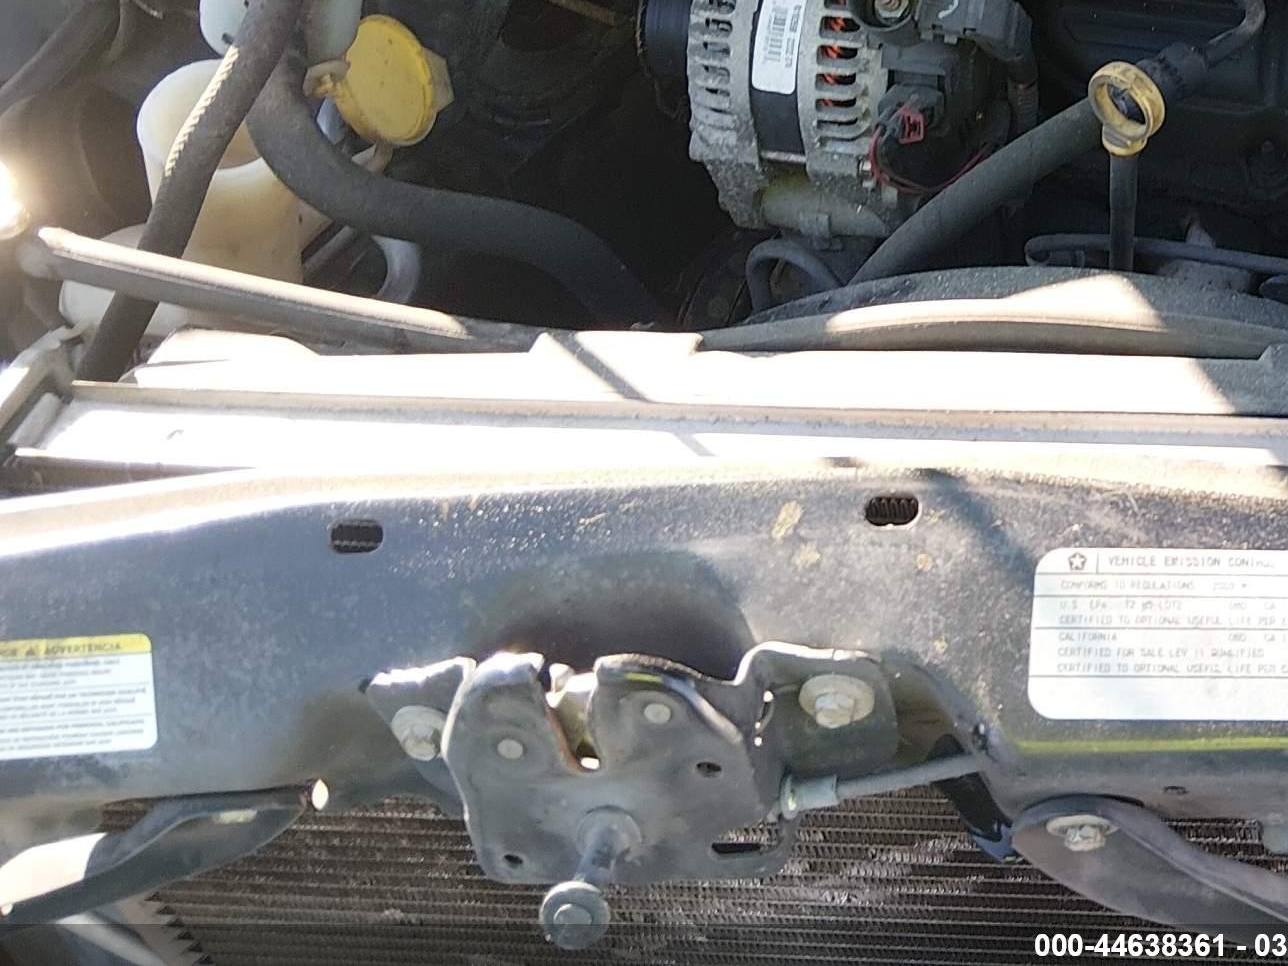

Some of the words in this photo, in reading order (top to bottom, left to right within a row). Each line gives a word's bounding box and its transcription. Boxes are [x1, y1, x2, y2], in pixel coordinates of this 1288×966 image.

[1109, 555, 1156, 567] VEHICLE
[1164, 556, 1220, 567] EMISSION
[1060, 580, 1107, 590] CONFORMS
[1130, 580, 1195, 591] REGULATIONS
[1059, 615, 1112, 625] CERTIFIED
[1120, 616, 1129, 625] TO
[1135, 616, 1180, 625] OPTIONAL
[1188, 616, 1222, 626] USEFUL
[1058, 632, 1117, 642] CALIFORNIA
[1057, 647, 1111, 657] CERTIFIED
[1117, 647, 1135, 657] FOR
[1140, 648, 1163, 658] SALE
[1057, 663, 1111, 673] CERTIFIED
[1117, 664, 1128, 673] TO
[1134, 664, 1179, 674] OPTIONAL
[1187, 664, 1219, 674] USEFUL
[1228, 664, 1251, 674] LIFE
